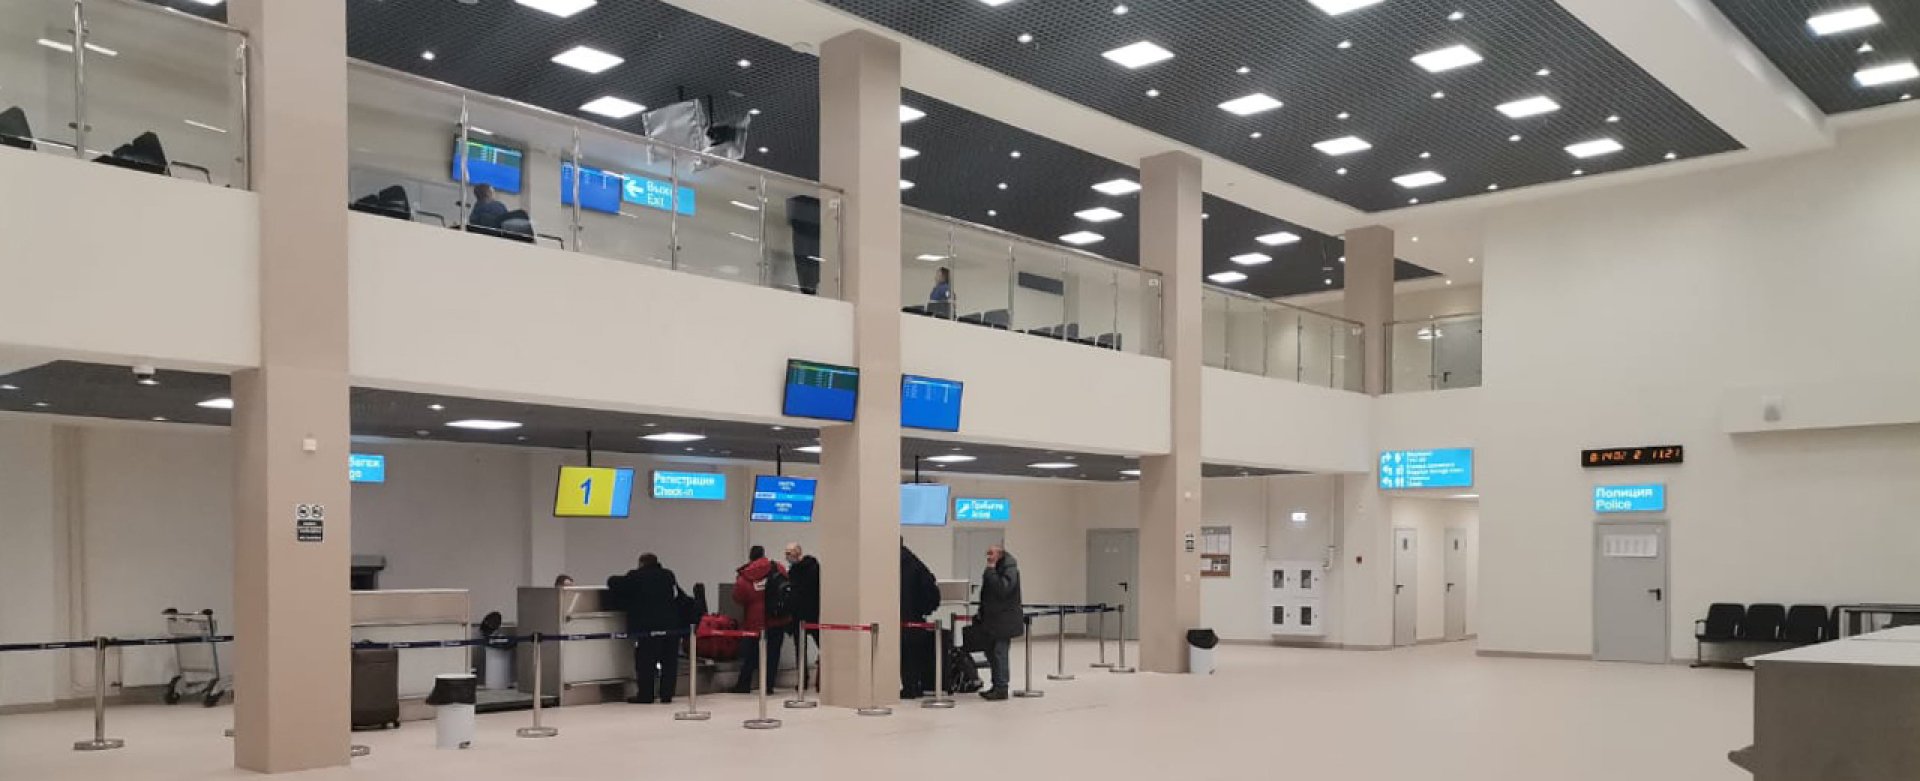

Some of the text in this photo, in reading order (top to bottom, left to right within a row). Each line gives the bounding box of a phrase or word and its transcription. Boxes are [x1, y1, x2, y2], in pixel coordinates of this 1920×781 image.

[647, 180, 673, 195] Выхо
[580, 479, 591, 505] 1
[1595, 487, 1653, 498] Полиция
[1595, 499, 1633, 511] Police
